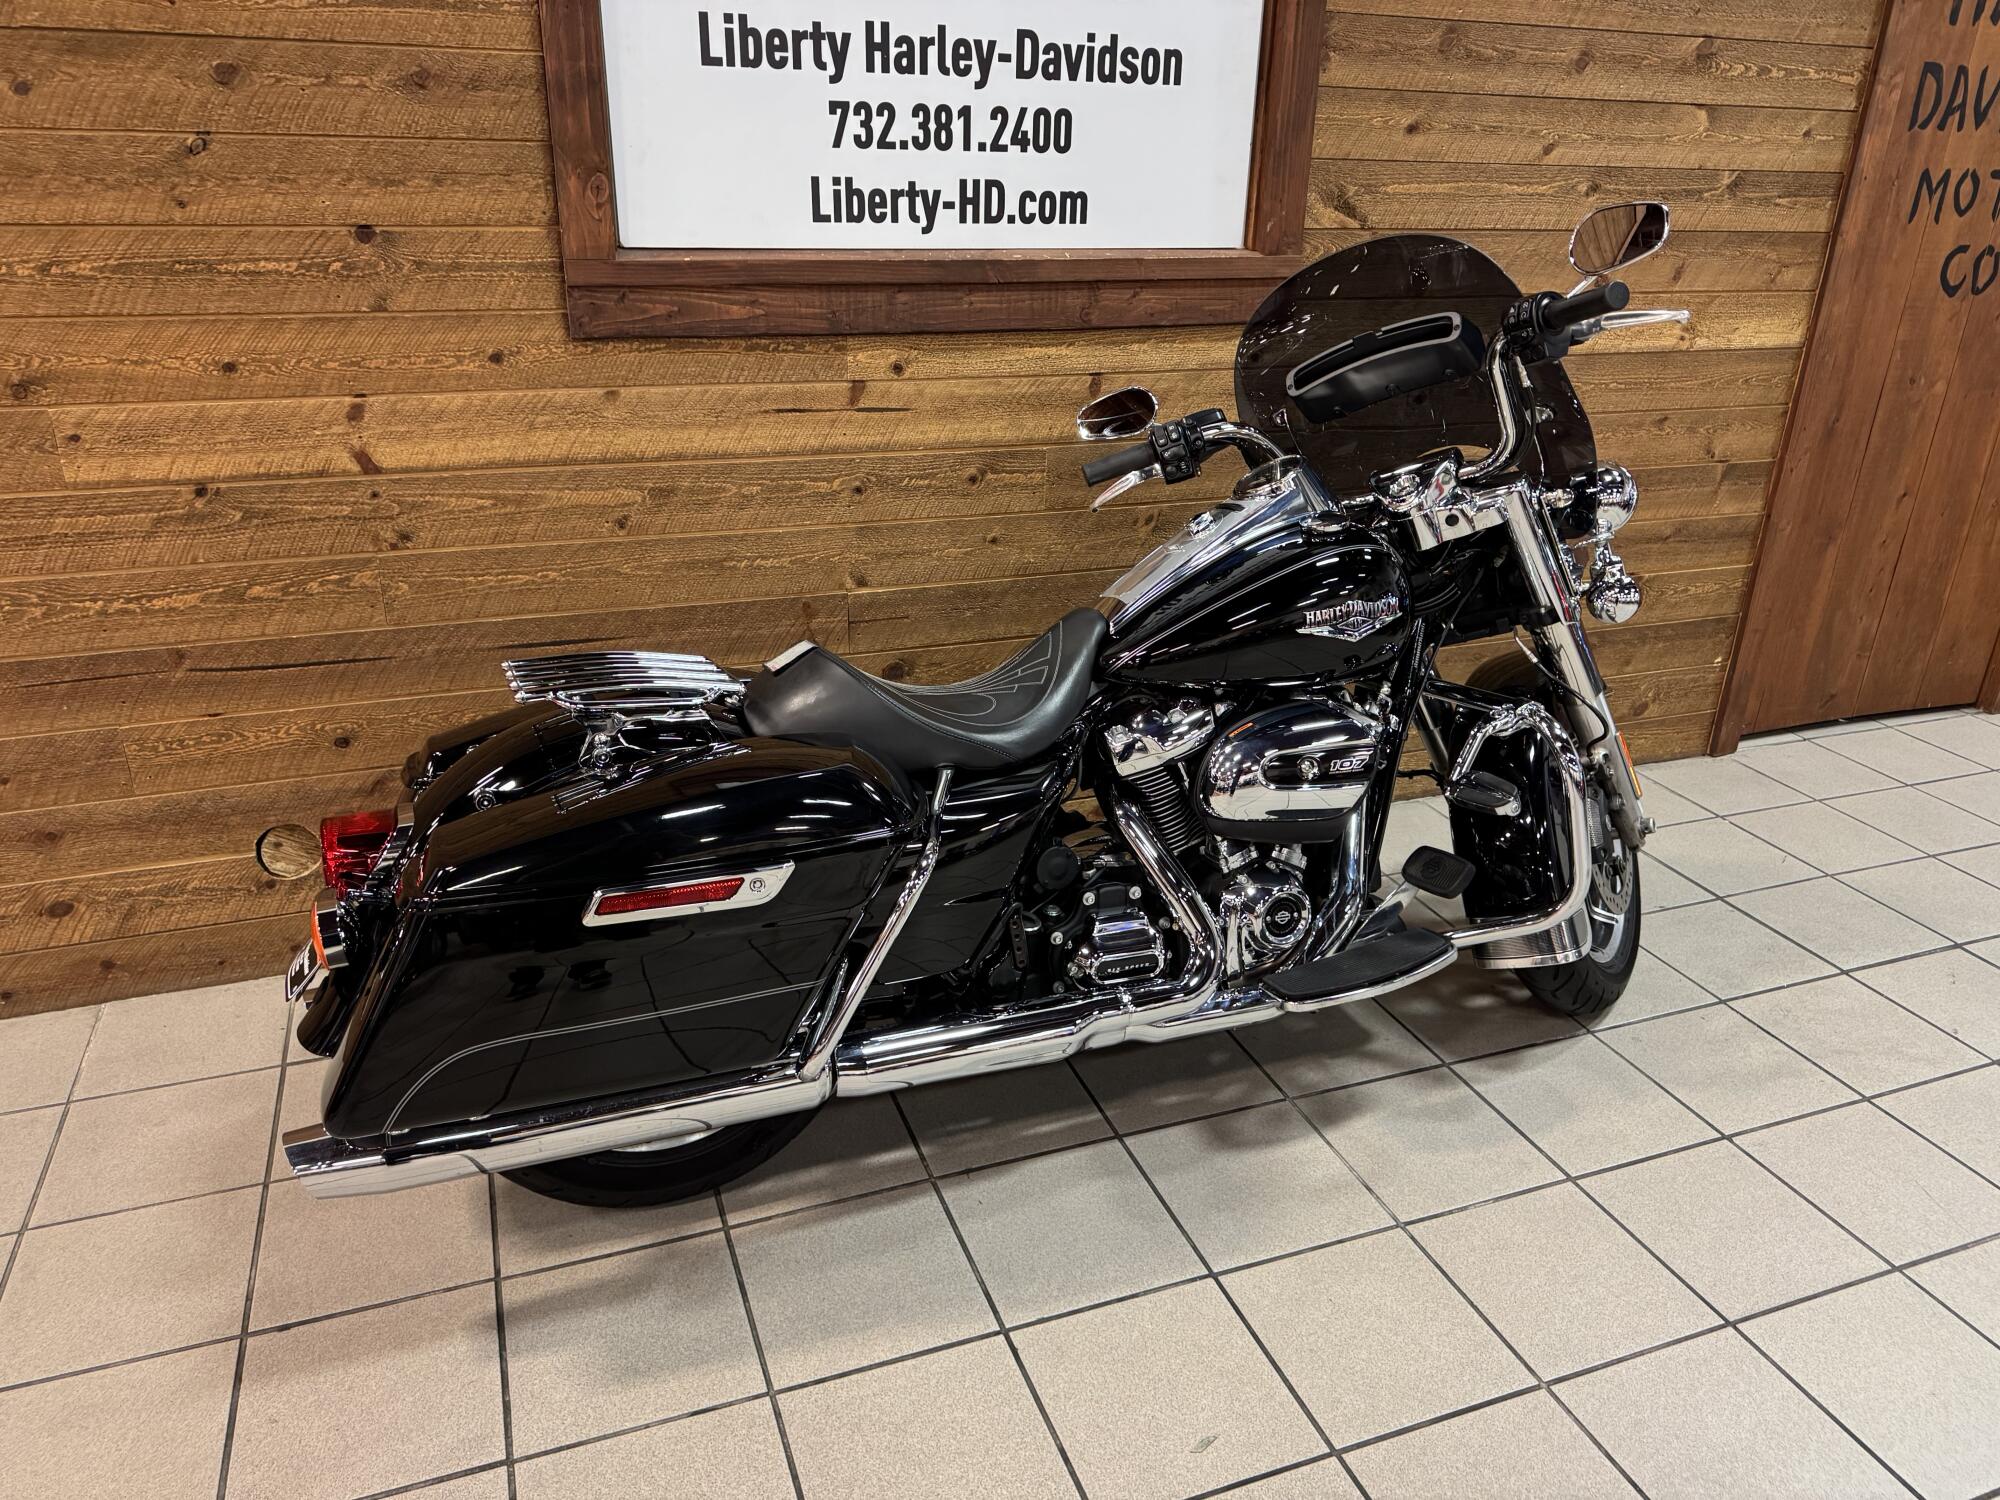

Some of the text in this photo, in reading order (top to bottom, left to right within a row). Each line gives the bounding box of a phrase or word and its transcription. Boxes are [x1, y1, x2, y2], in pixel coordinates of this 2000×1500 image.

[699, 11, 1182, 89] Liberty Harley-Davidson
[829, 101, 1072, 154] 732.381.2400
[811, 176, 1087, 234] Liberty-HD.com
[1303, 597, 1400, 628] HARLEY-DAVIDSON
[1330, 755, 1369, 771] 107
